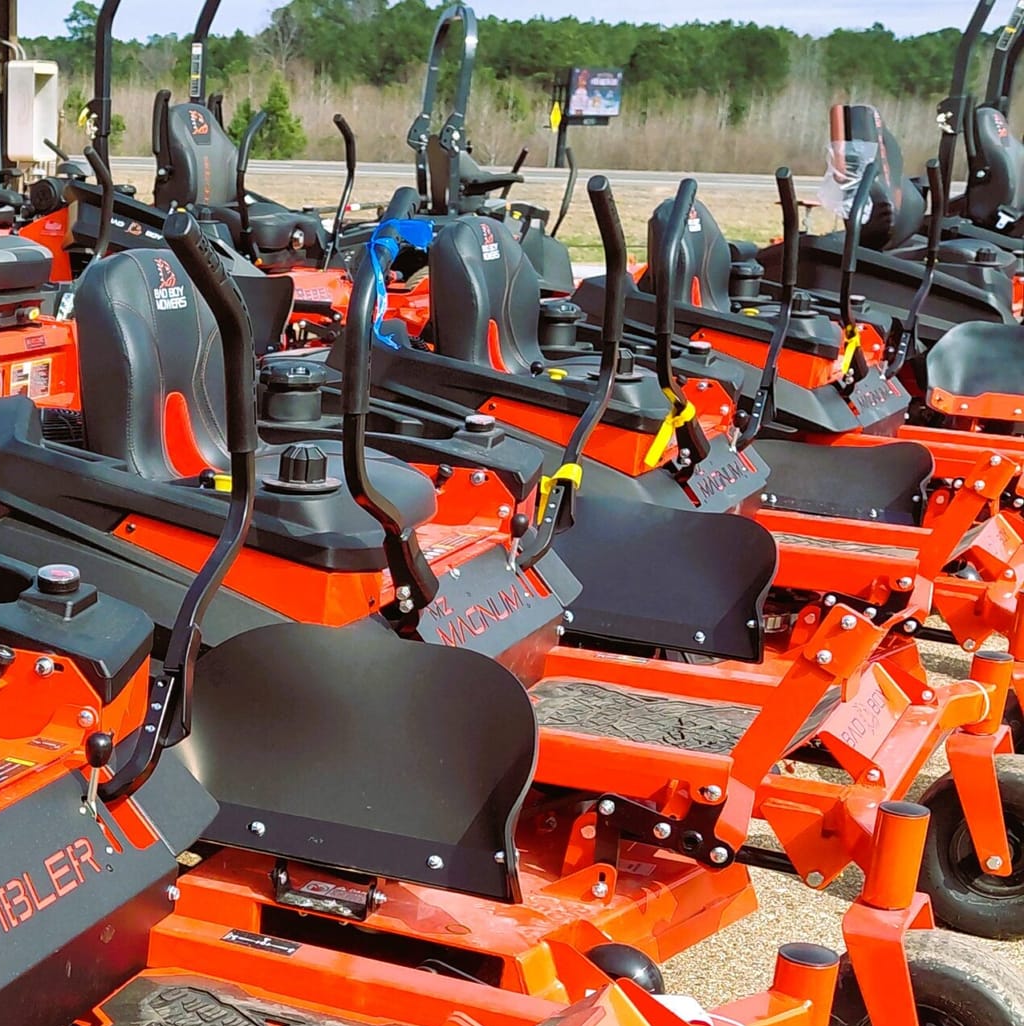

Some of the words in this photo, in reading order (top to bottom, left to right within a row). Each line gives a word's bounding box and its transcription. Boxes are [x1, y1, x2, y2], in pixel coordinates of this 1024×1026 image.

[169, 285, 184, 298] BOY
[155, 296, 188, 311] MOWERS
[426, 595, 454, 621] MZ
[436, 583, 524, 647] MAGNUM
